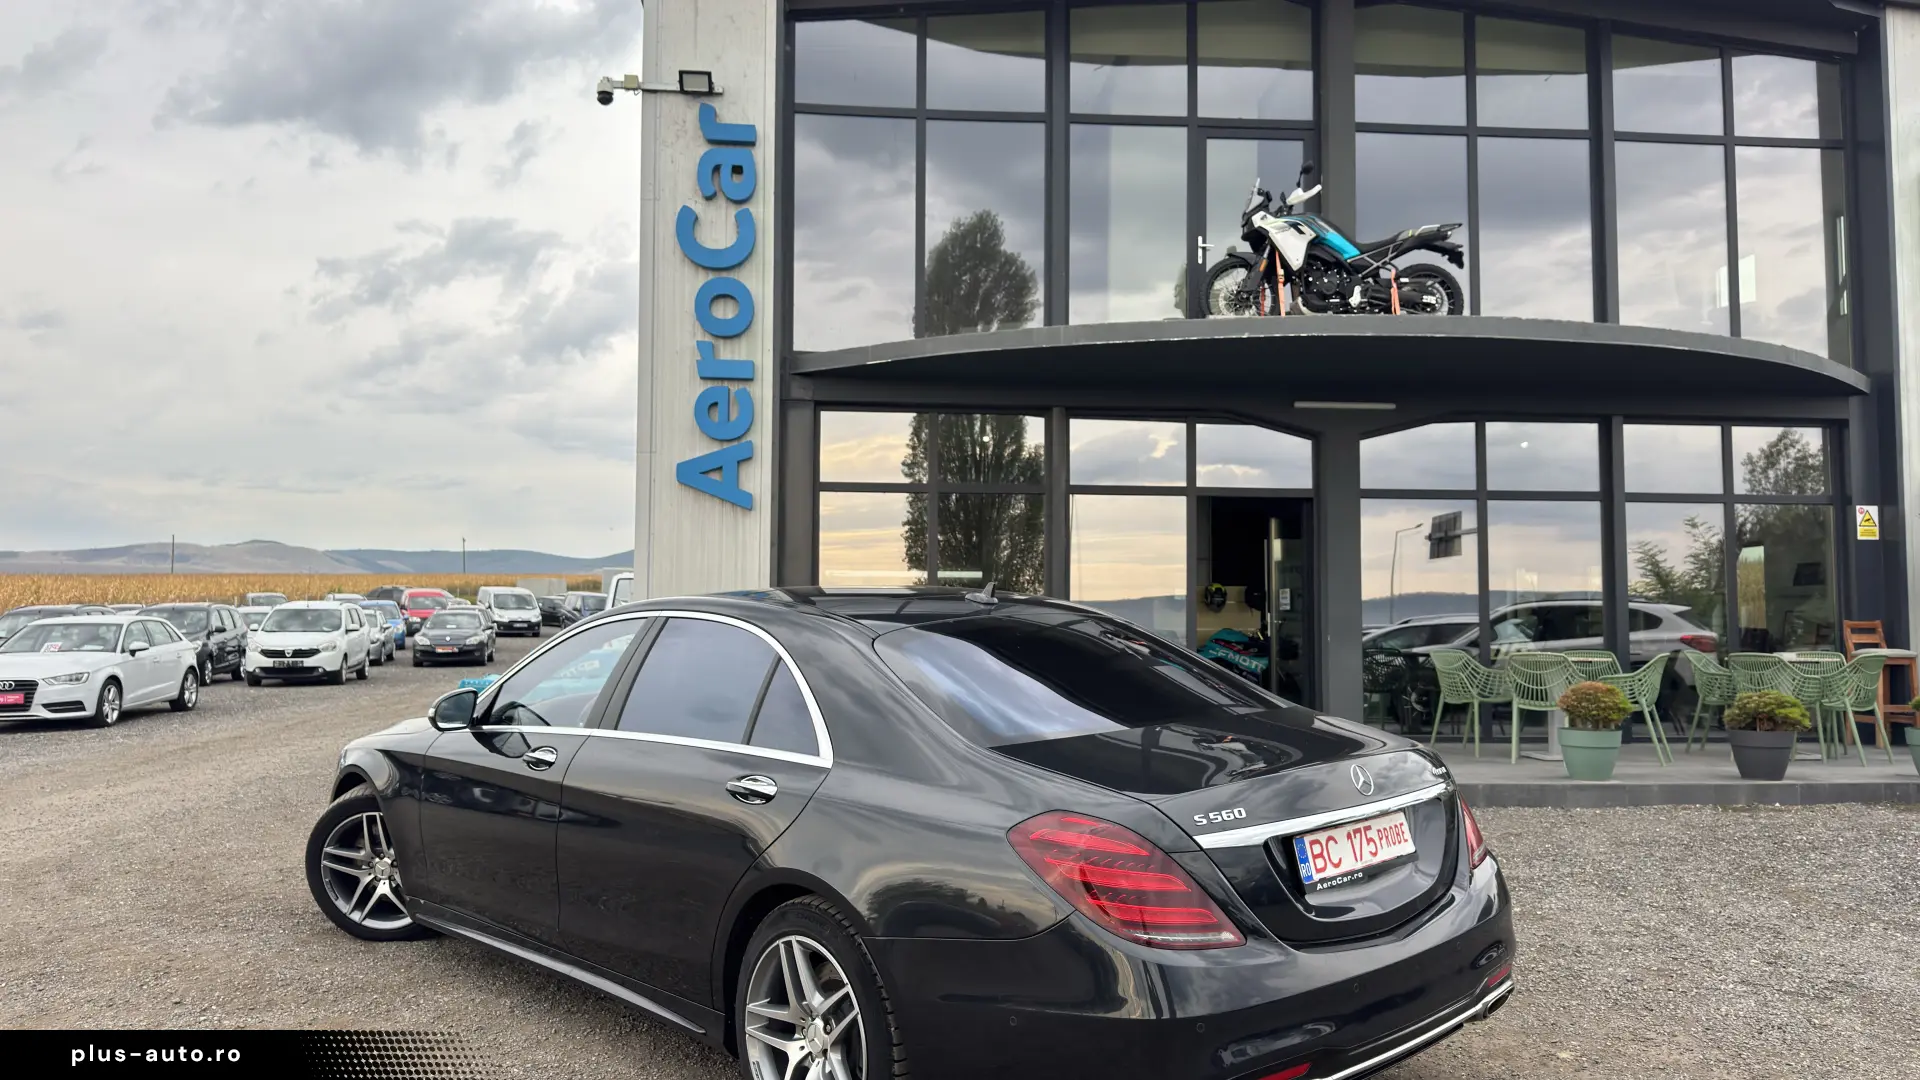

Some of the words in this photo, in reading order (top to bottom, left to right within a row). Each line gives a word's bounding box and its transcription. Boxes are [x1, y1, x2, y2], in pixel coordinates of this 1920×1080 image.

[676, 102, 757, 511] AeroCar
[1193, 814, 1207, 826] S
[1209, 807, 1247, 823] 560
[1309, 835, 1342, 874] BC
[1347, 825, 1379, 864] 175
[1377, 822, 1409, 850] PROBE
[1301, 862, 1312, 878] RO
[1316, 871, 1364, 890] AeroCar.ro
